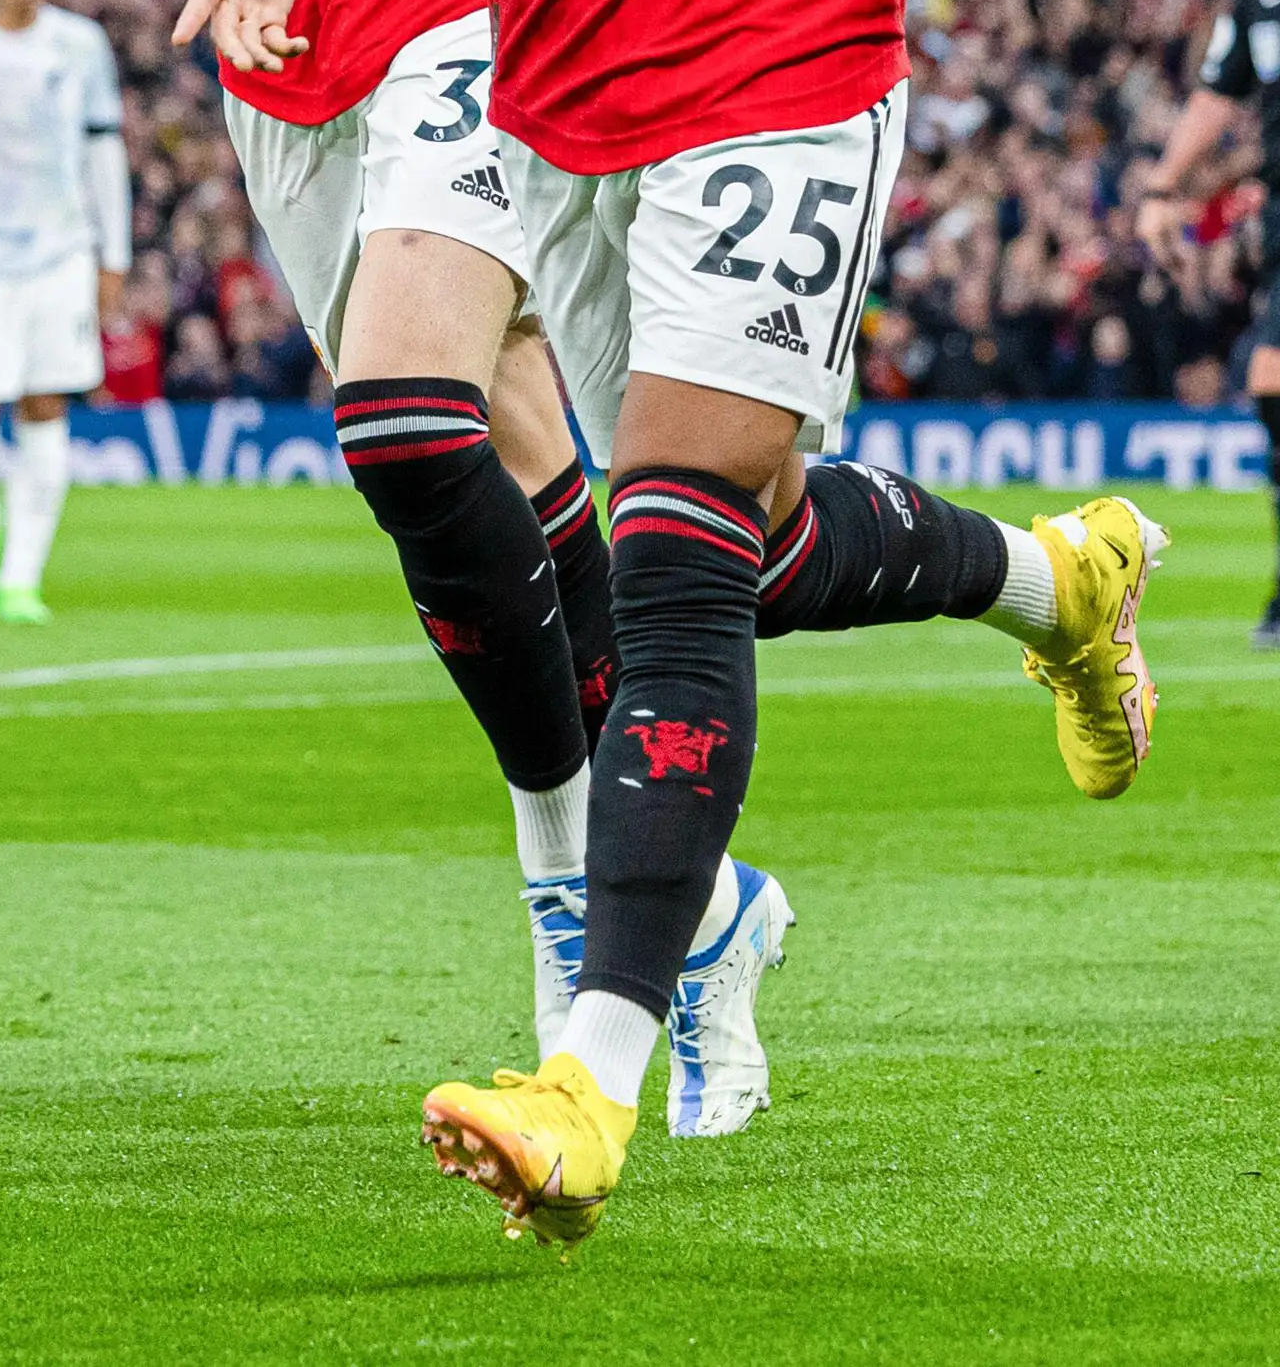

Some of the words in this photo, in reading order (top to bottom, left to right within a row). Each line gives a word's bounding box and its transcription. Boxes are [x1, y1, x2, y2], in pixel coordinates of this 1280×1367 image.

[450, 177, 511, 212] adidas
[692, 164, 859, 298] 25
[744, 323, 810, 357] adidas
